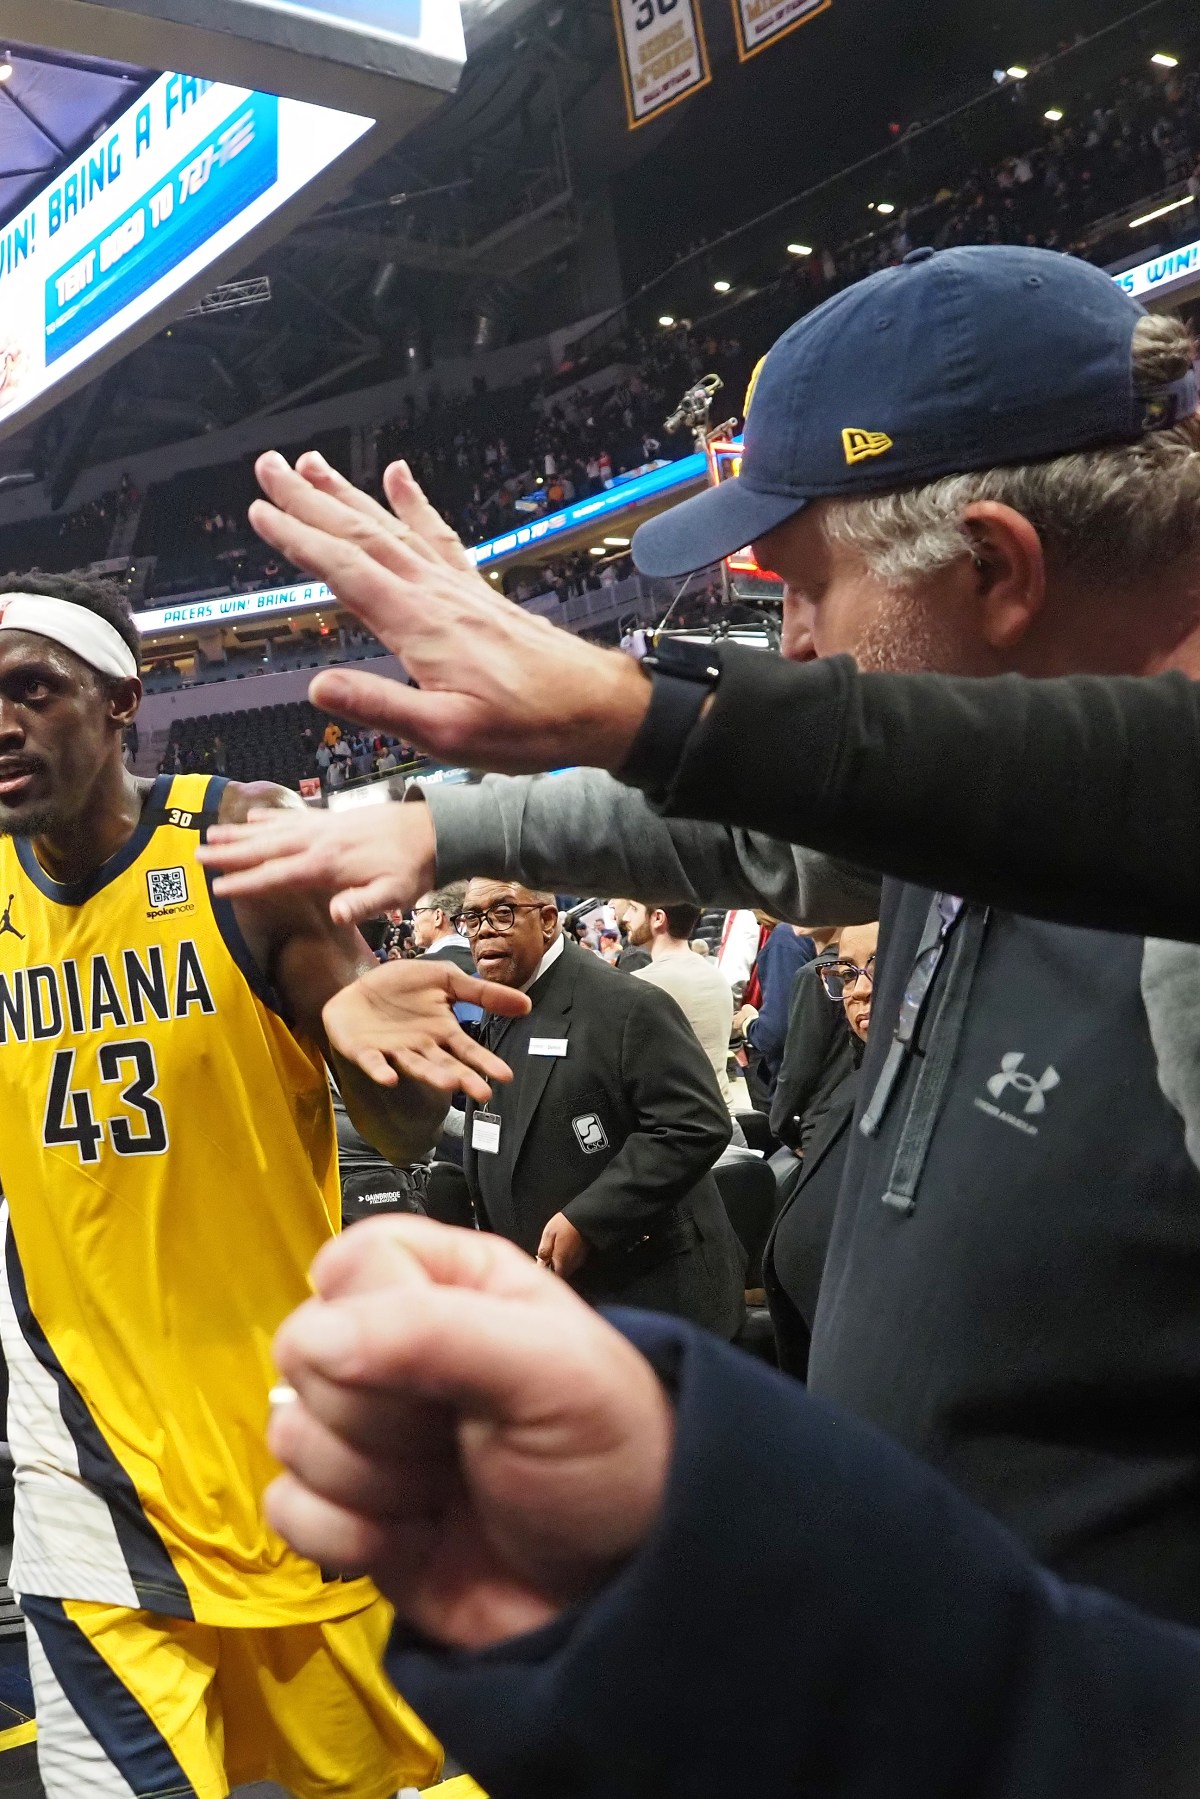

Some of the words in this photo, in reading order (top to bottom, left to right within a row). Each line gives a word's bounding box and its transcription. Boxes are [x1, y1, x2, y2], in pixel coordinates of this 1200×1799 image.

[48, 133, 121, 238] BRING
[135, 102, 150, 159] A
[99, 207, 145, 272] BOGO
[149, 181, 174, 228] TO
[1147, 248, 1198, 283] WIN!
[164, 605, 212, 624] PACERS
[220, 599, 250, 614] WIN!
[257, 591, 296, 608] BRING
[303, 588, 312, 600] A
[168, 808, 192, 828] 30
[146, 901, 195, 919] spokenote
[42, 1037, 169, 1165] 43
[586, 1140, 605, 1152] CSC
[364, 1191, 401, 1202] GAINBRIDGE
